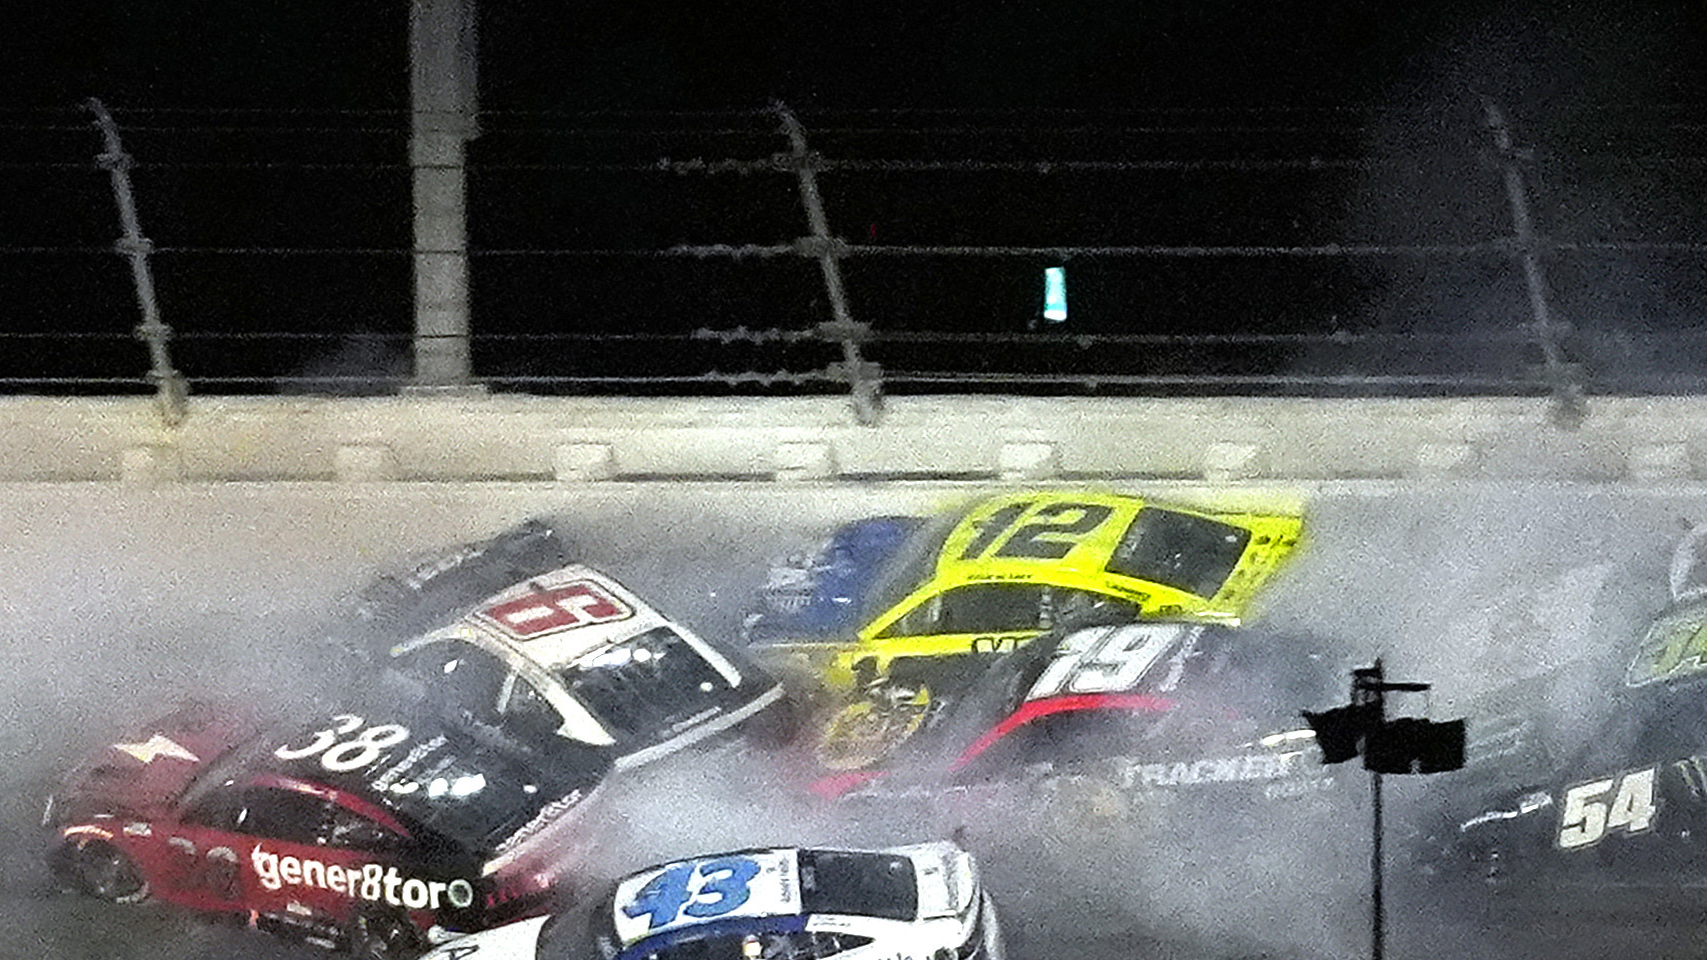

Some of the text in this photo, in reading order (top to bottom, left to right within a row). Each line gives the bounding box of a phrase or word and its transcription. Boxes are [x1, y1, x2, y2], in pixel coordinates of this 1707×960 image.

[960, 501, 1116, 560] 12
[1024, 622, 1183, 702] 19
[274, 713, 411, 772] 38
[1559, 768, 1659, 848] 54
[622, 858, 761, 930] 43
